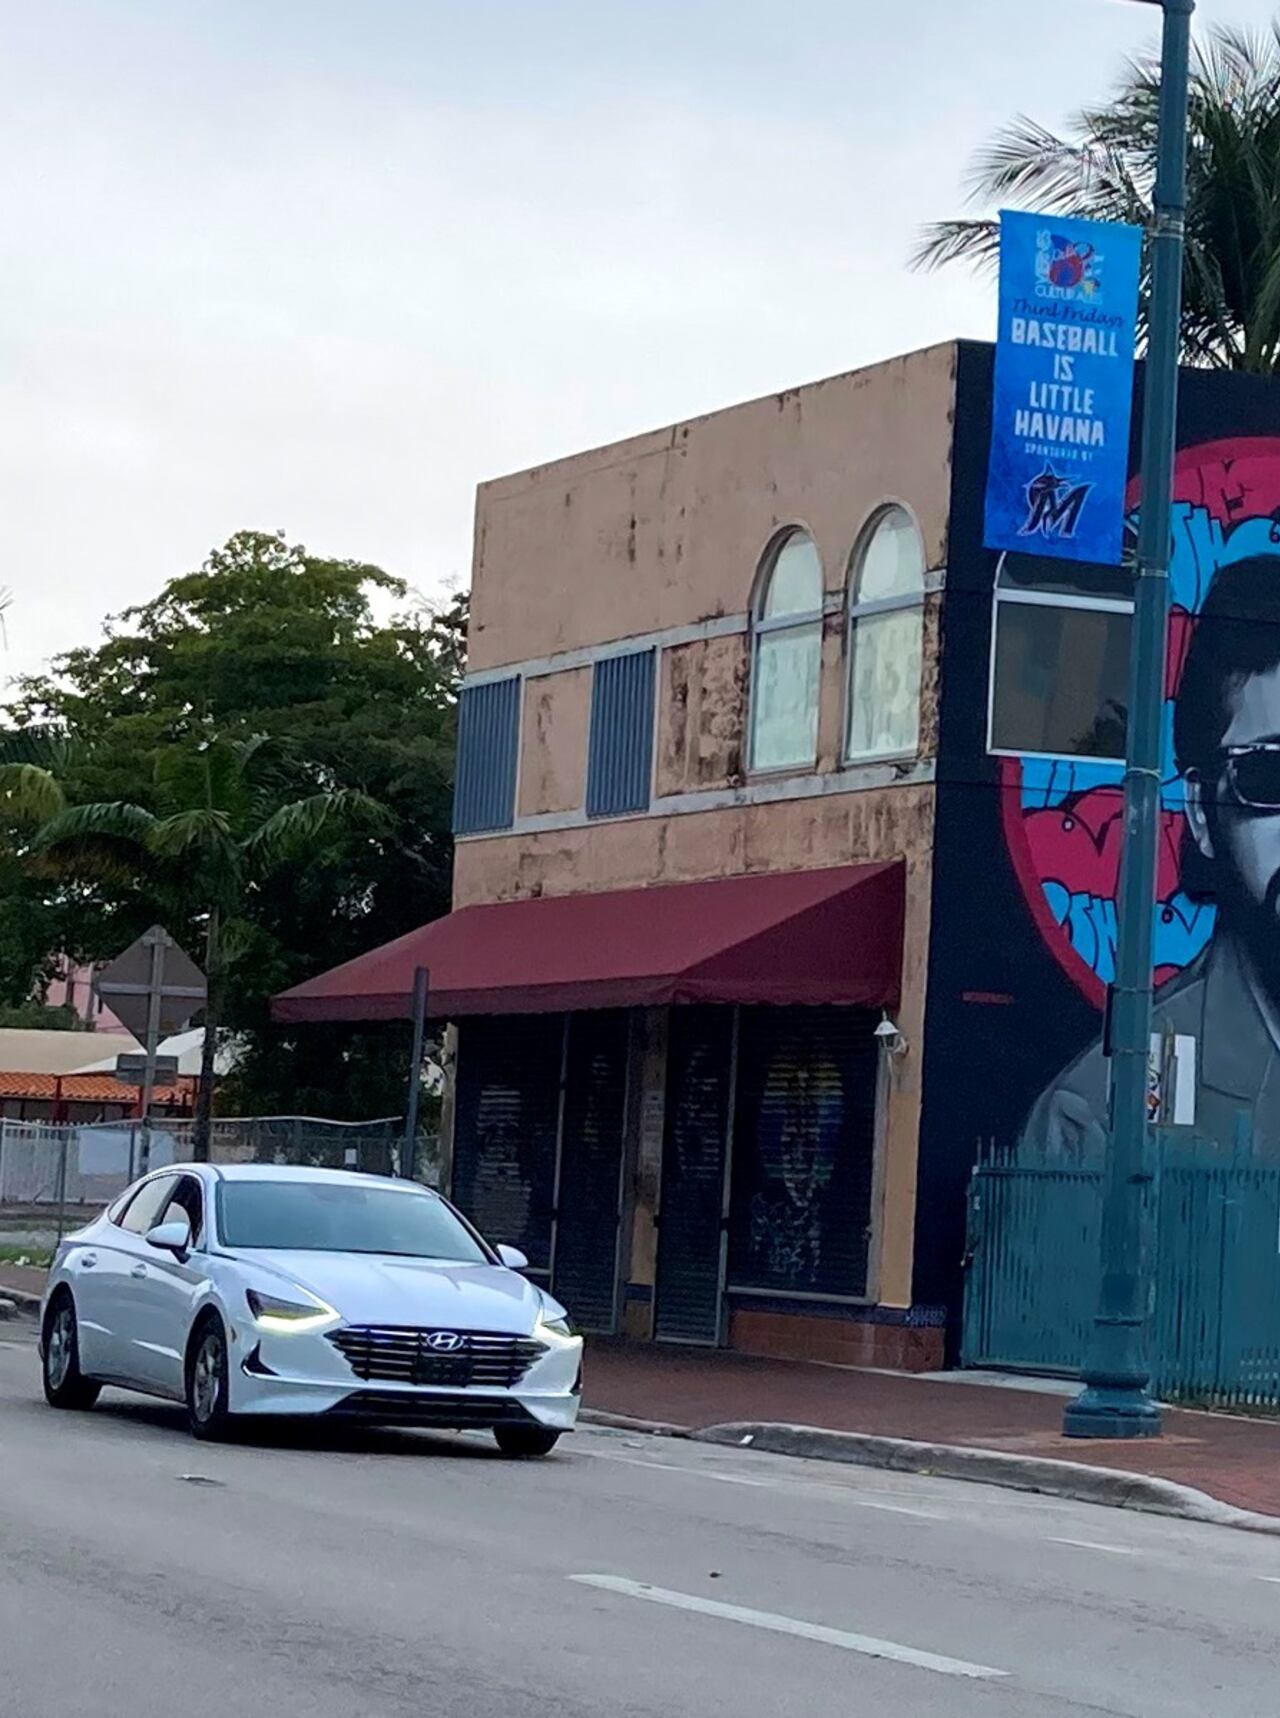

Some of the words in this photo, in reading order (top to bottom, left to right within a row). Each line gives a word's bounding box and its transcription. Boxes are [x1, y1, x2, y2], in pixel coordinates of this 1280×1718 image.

[1011, 317, 1119, 357] BASEBALL
[1053, 354, 1075, 382] IS
[1029, 381, 1095, 415] LITTLE
[1014, 409, 1105, 447] HAVANA
